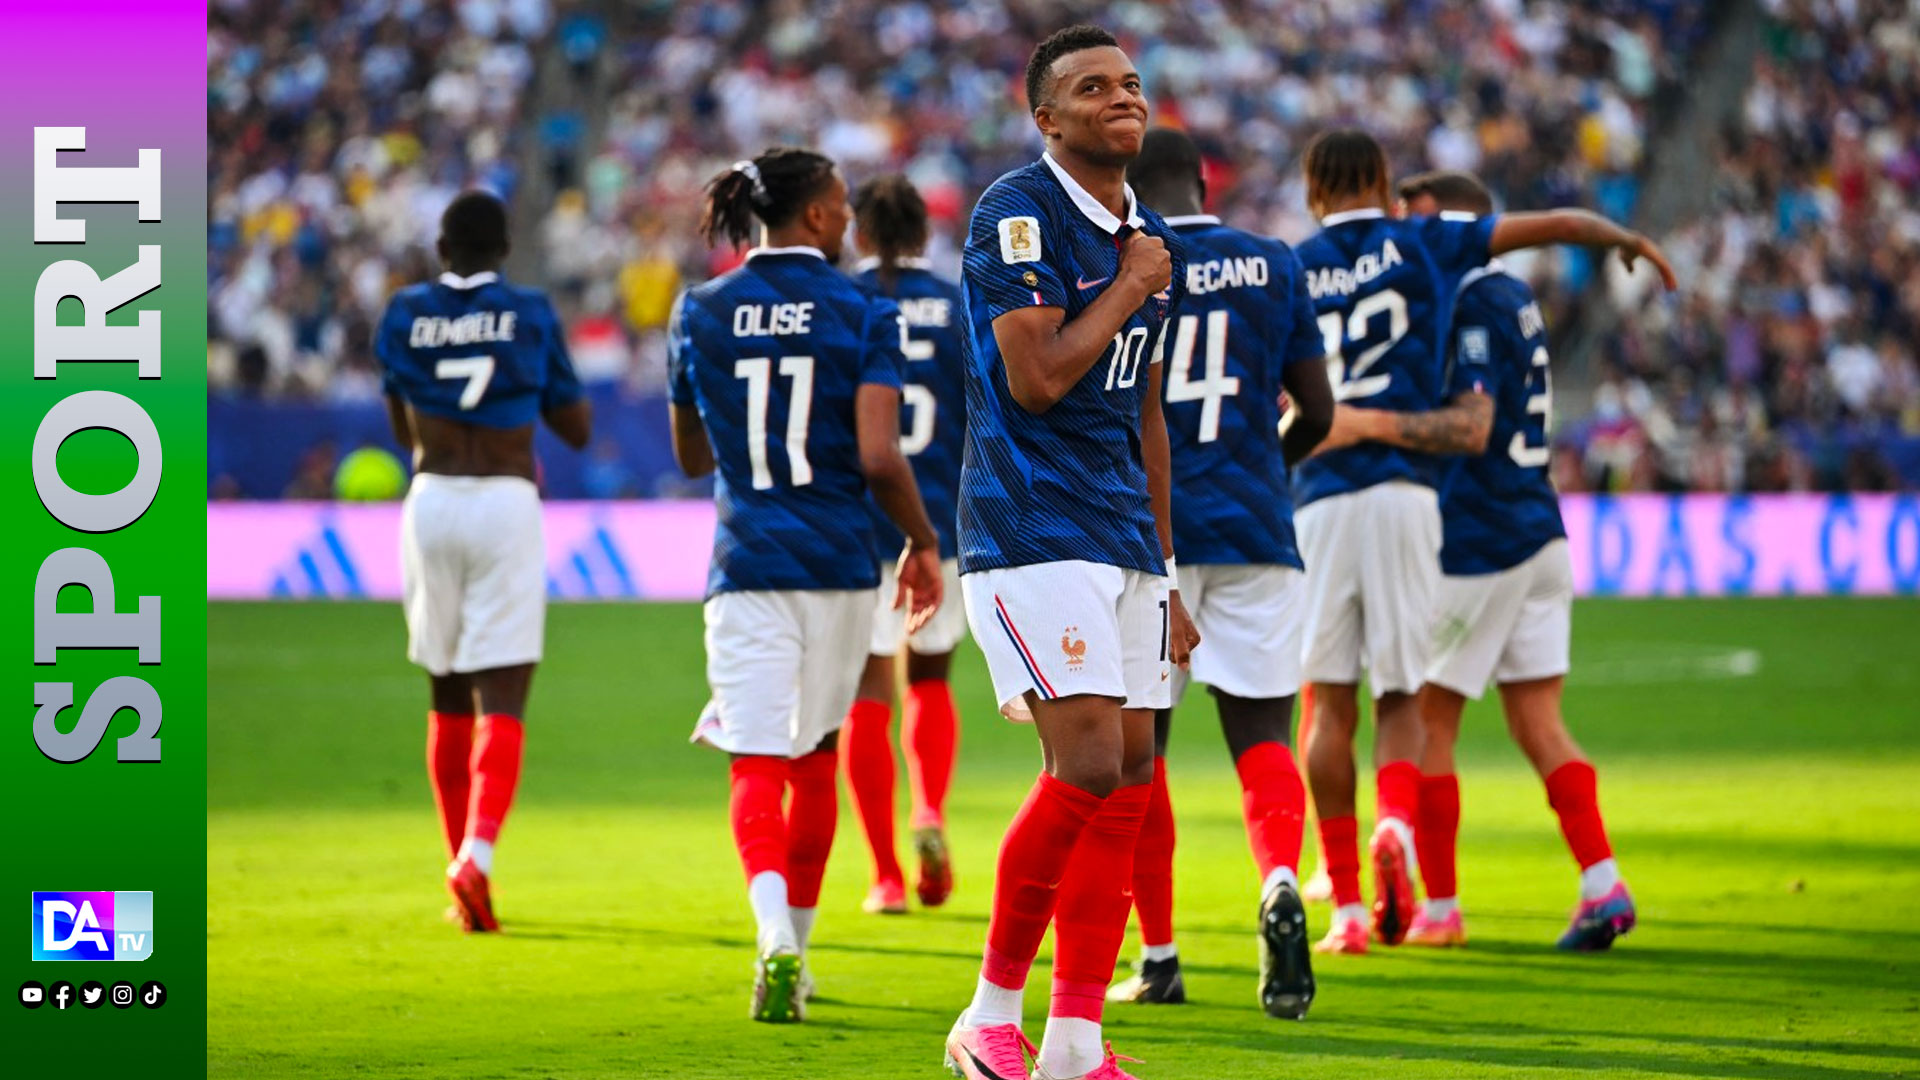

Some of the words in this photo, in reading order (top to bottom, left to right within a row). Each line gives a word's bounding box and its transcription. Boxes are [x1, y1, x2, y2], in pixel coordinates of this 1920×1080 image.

[733, 302, 815, 337] OLISE
[1104, 326, 1148, 391] 10
[1165, 309, 1240, 444] 4
[1316, 287, 1409, 402] 12
[435, 355, 496, 411] 7
[734, 355, 815, 490] 11
[1508, 345, 1554, 468] 3
